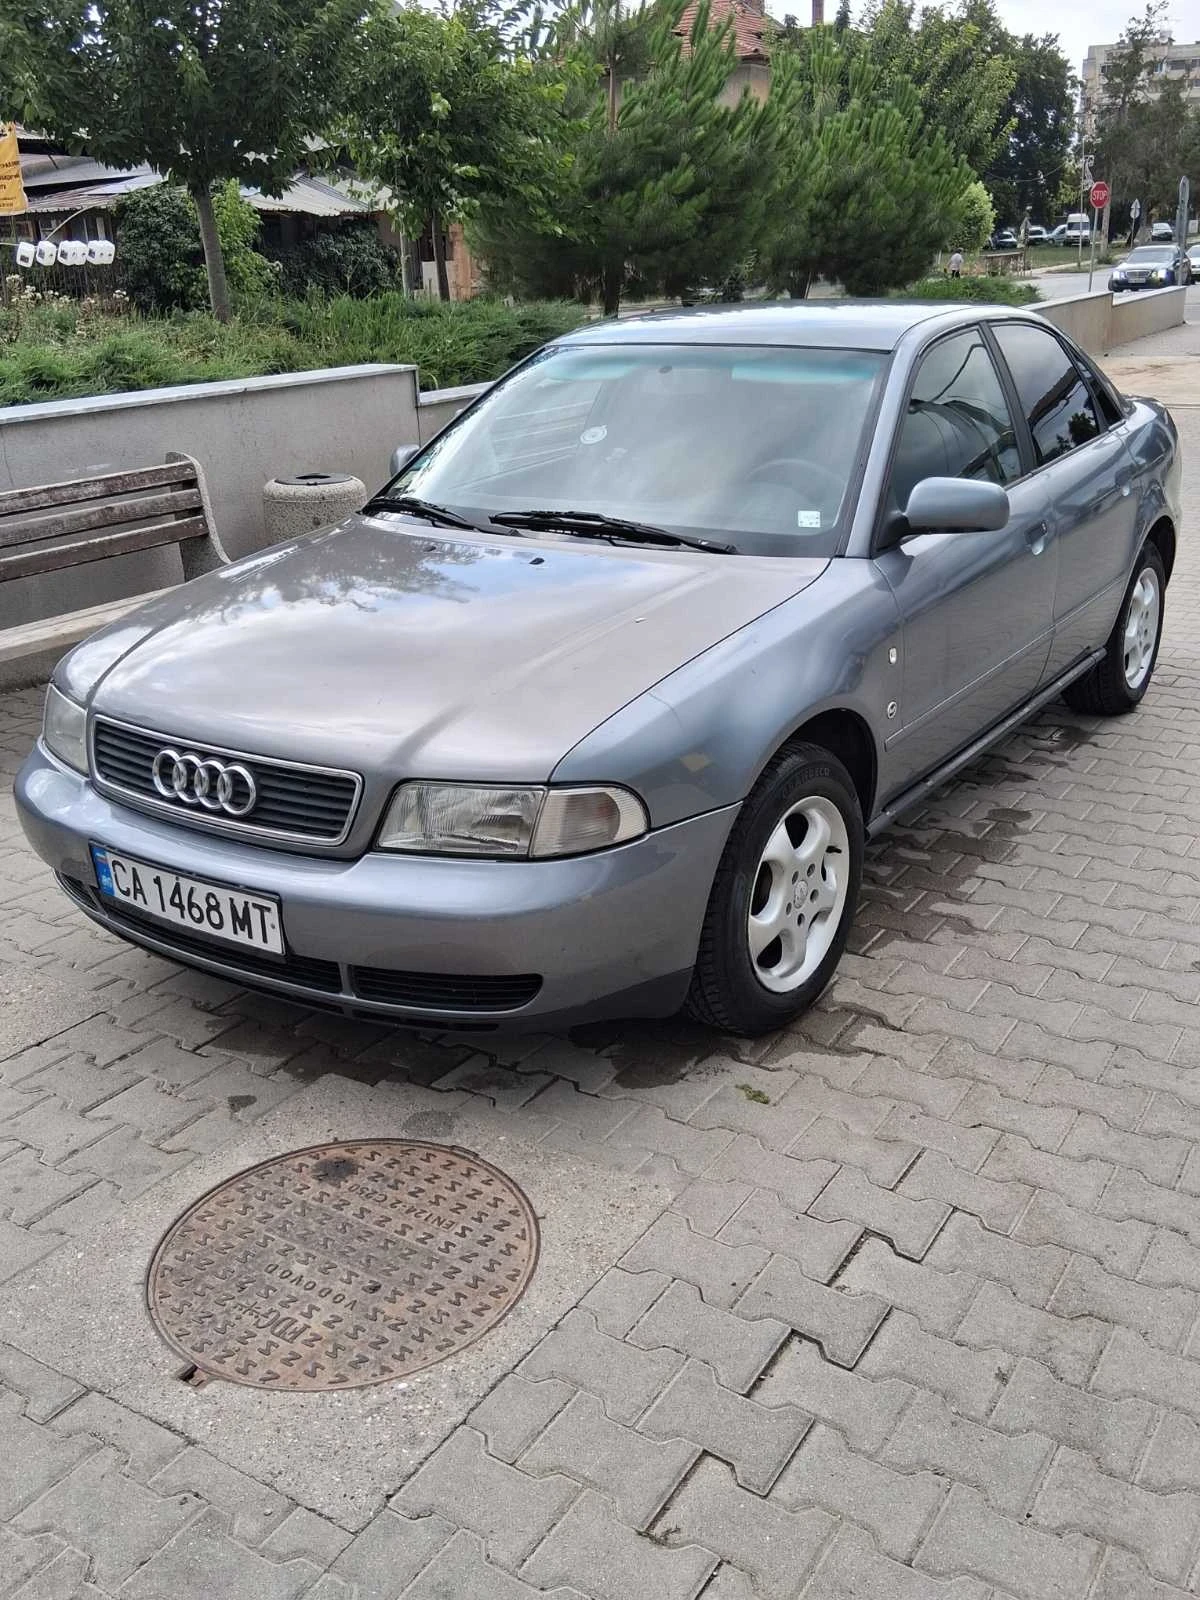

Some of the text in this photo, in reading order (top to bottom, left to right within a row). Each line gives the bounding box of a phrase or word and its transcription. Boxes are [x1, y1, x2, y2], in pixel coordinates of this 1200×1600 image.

[1092, 190, 1107, 201] STOP
[111, 859, 272, 944] CA 1468 MT
[264, 1263, 357, 1311] VODOVOD
